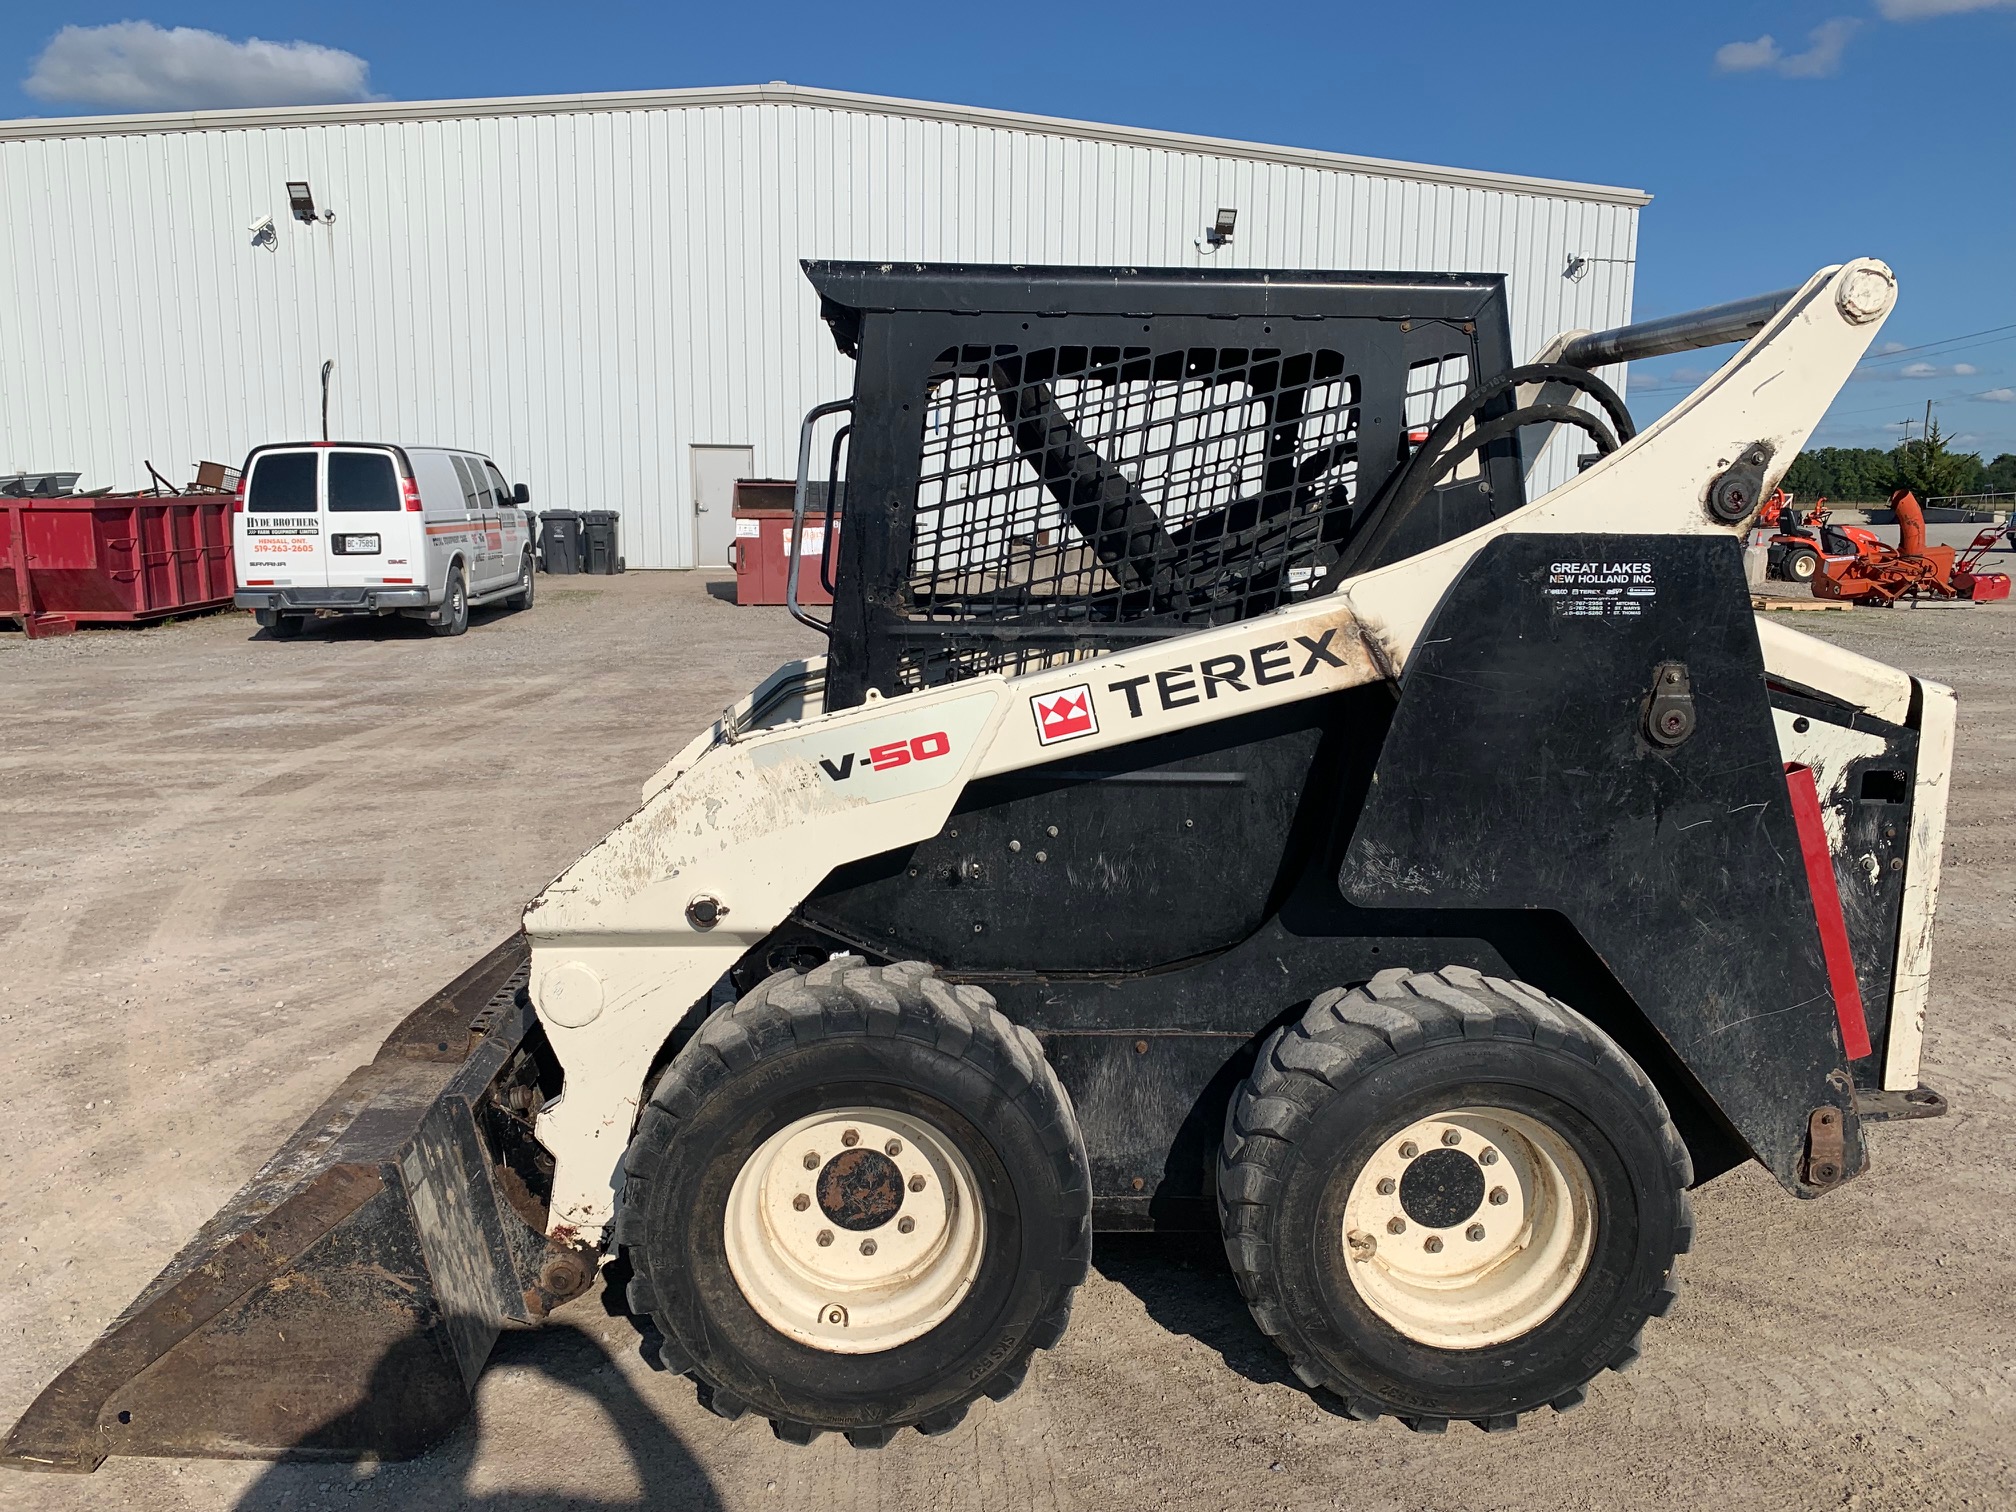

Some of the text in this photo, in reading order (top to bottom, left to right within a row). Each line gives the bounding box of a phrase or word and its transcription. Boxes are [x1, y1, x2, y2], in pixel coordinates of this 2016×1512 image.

[247, 517, 319, 527] HYDE BROTHERS
[254, 544, 314, 553] 519-263-2605
[1550, 563, 1652, 574] GREAT LAKES
[1549, 575, 1655, 584] NEW HOLLAND INC.
[1108, 628, 1348, 718] TEREX
[819, 731, 950, 781] V-50
